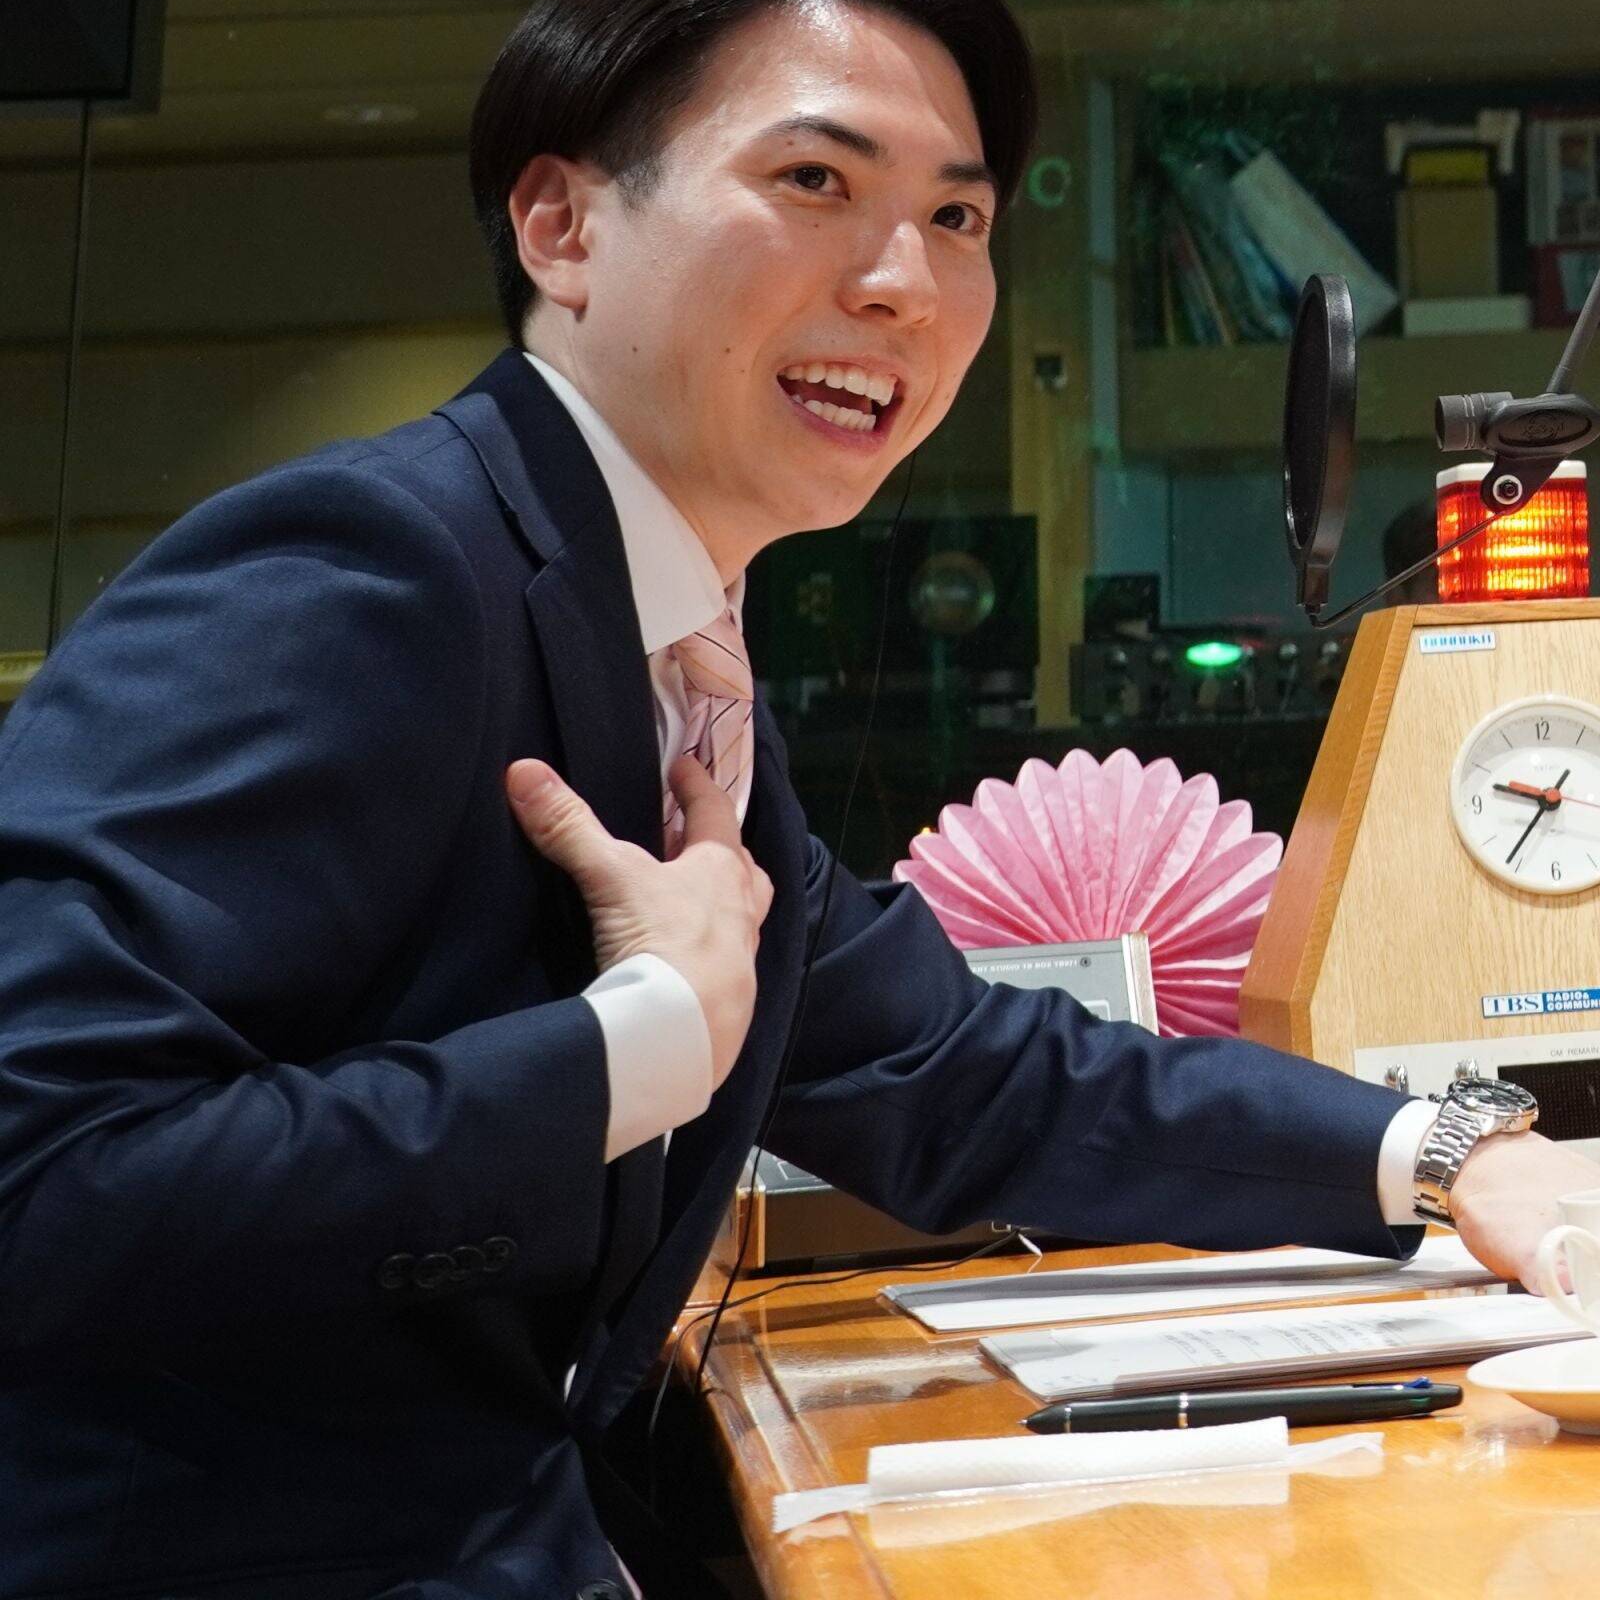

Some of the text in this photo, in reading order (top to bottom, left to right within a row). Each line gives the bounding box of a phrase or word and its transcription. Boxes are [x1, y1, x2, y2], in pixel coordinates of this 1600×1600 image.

[1535, 720, 1550, 741] 12
[1471, 794, 1483, 815] 9
[1551, 860, 1562, 881] 6
[1486, 996, 1539, 1012] TBS
